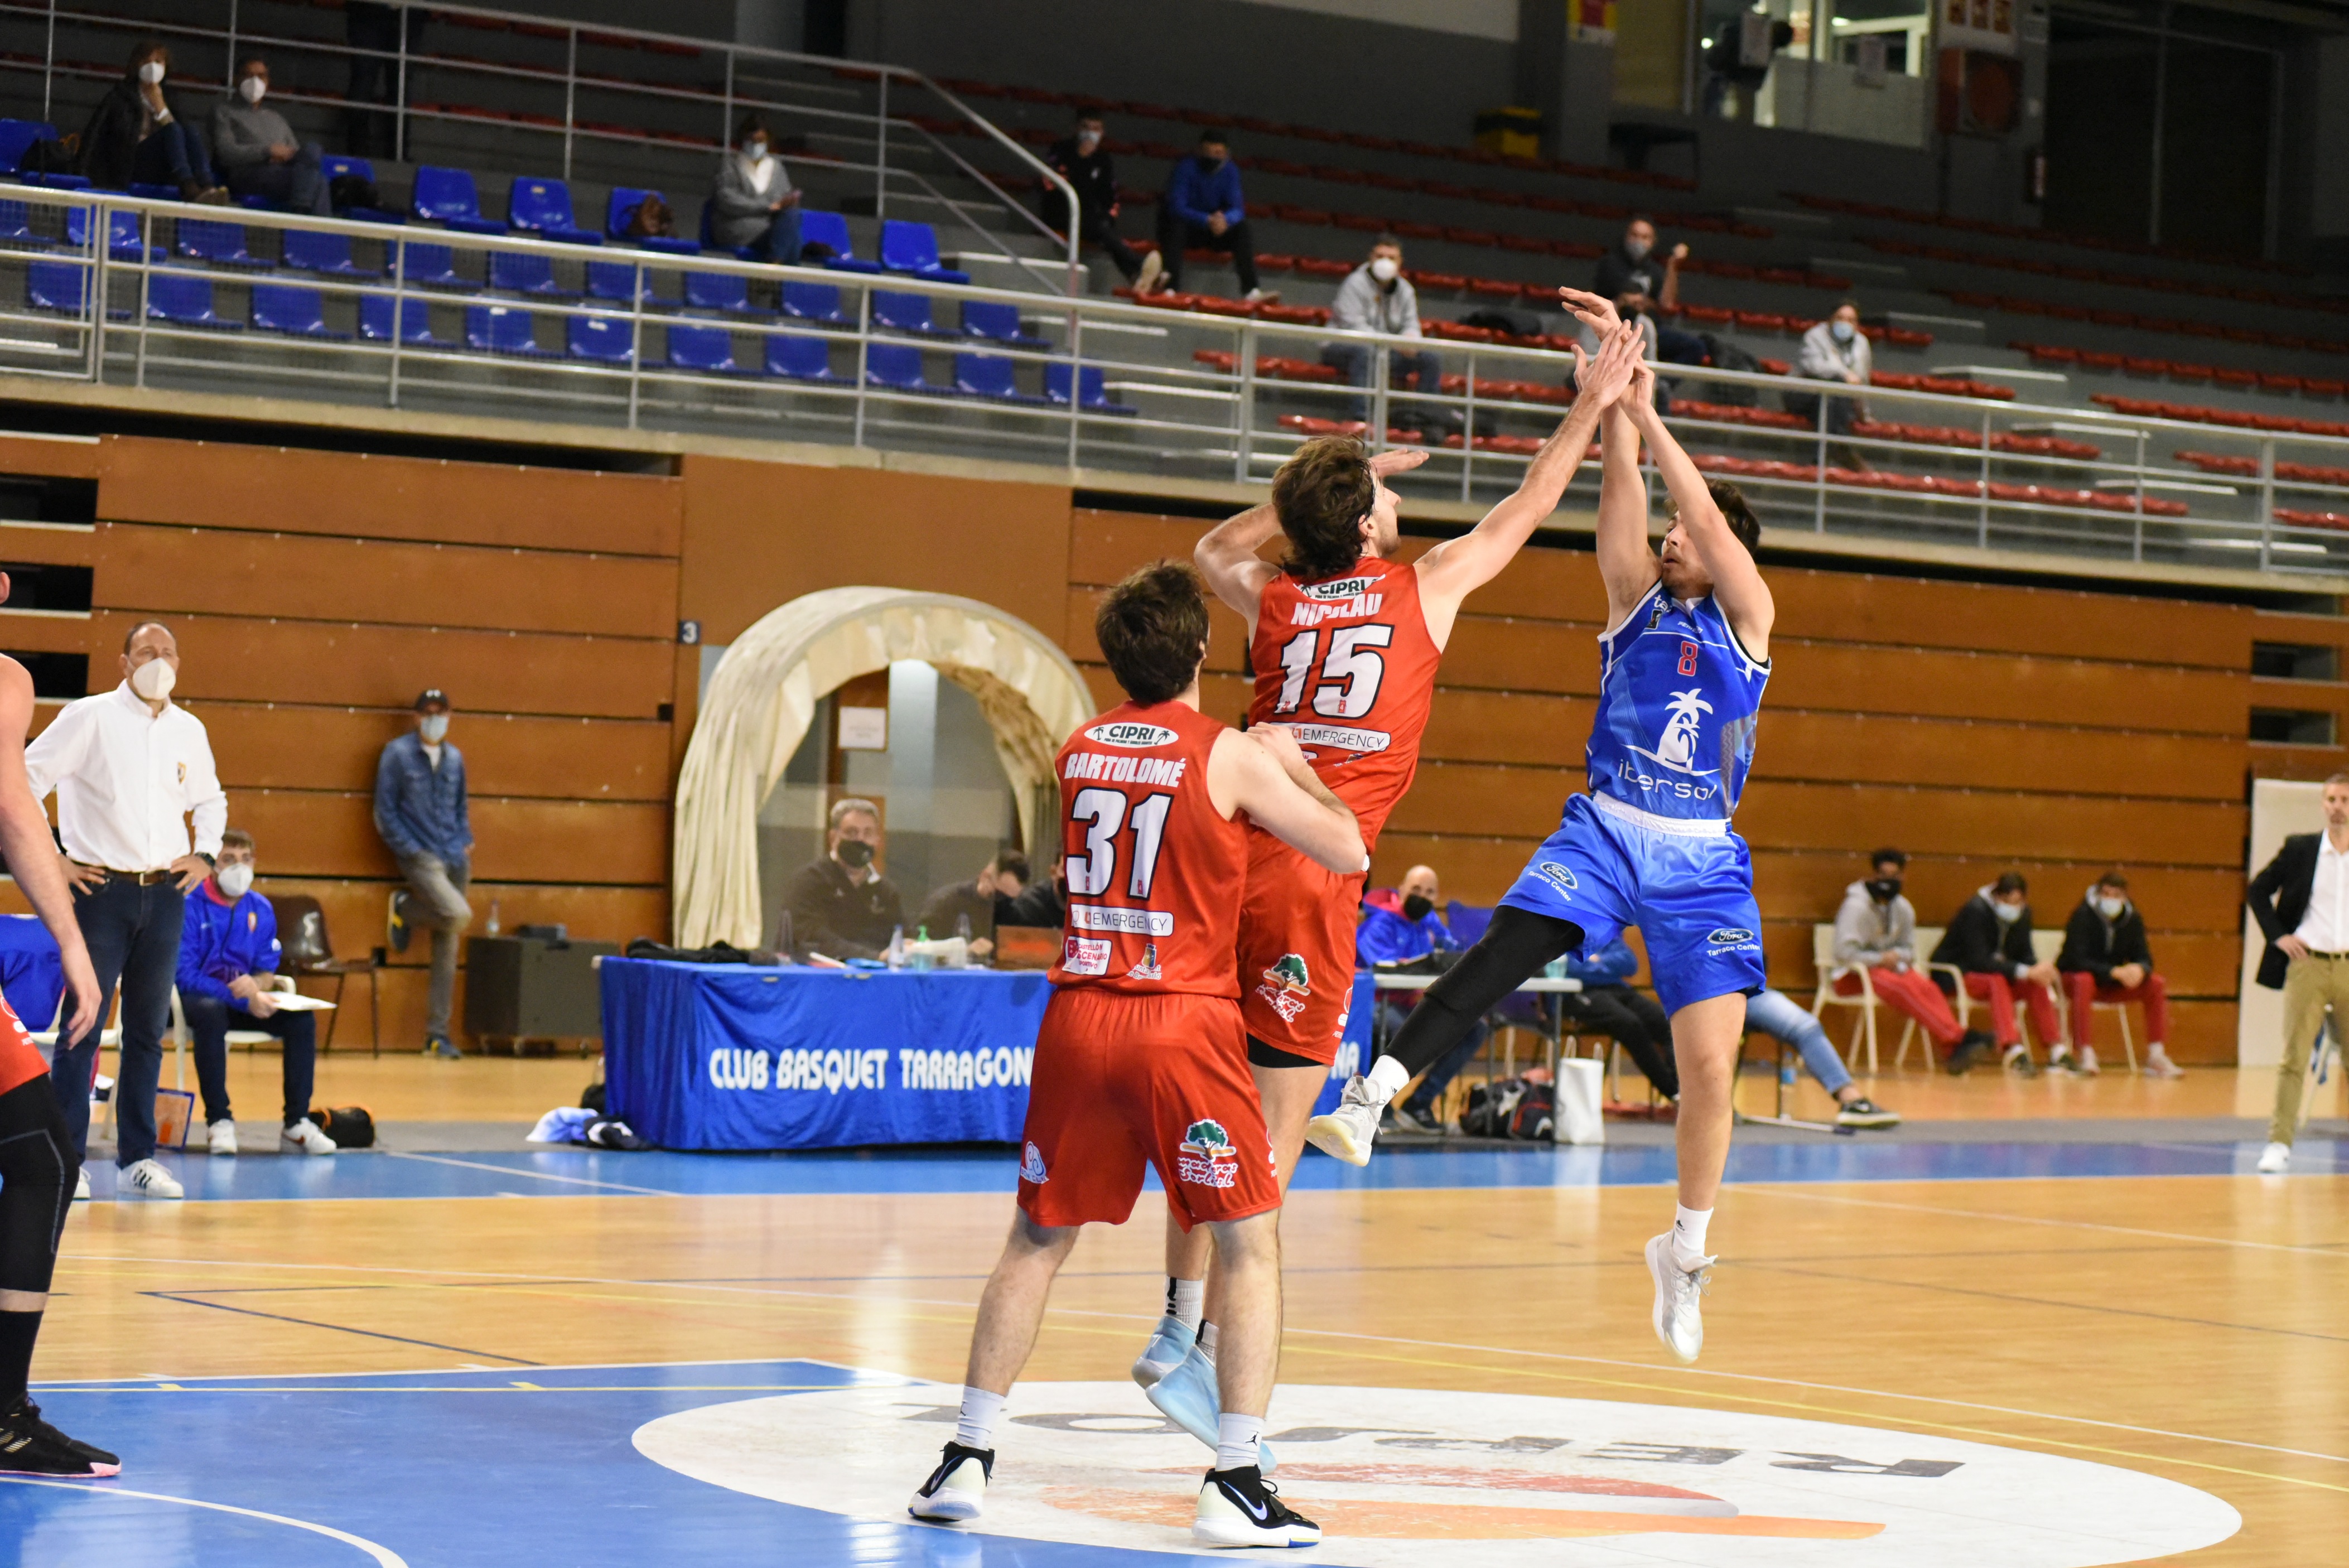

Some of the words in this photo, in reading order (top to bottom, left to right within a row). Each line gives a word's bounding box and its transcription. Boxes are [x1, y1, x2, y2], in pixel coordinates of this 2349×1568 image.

[1318, 579, 1366, 594] CIPRI
[683, 621, 697, 644] 3
[1274, 623, 1395, 720] 15
[1677, 640, 1698, 677] 8
[1109, 725, 1156, 740] CIPRI
[1303, 728, 1385, 748] EMERGENCY
[1064, 753, 1186, 787] BARTOLOMÉ
[1618, 759, 1718, 800] ibersol
[1065, 787, 1174, 900] 31
[1528, 870, 1551, 884] Tarraco
[1551, 880, 1572, 903] Center
[1093, 912, 1167, 931] EMERGENCY
[1077, 950, 1107, 961] SCENARIO
[1706, 945, 1735, 957] Tarraco
[1737, 943, 1760, 952] Center
[709, 1048, 770, 1091] CLUB
[776, 1048, 889, 1095] BASQUET
[899, 1046, 1034, 1091] TARRAGON
